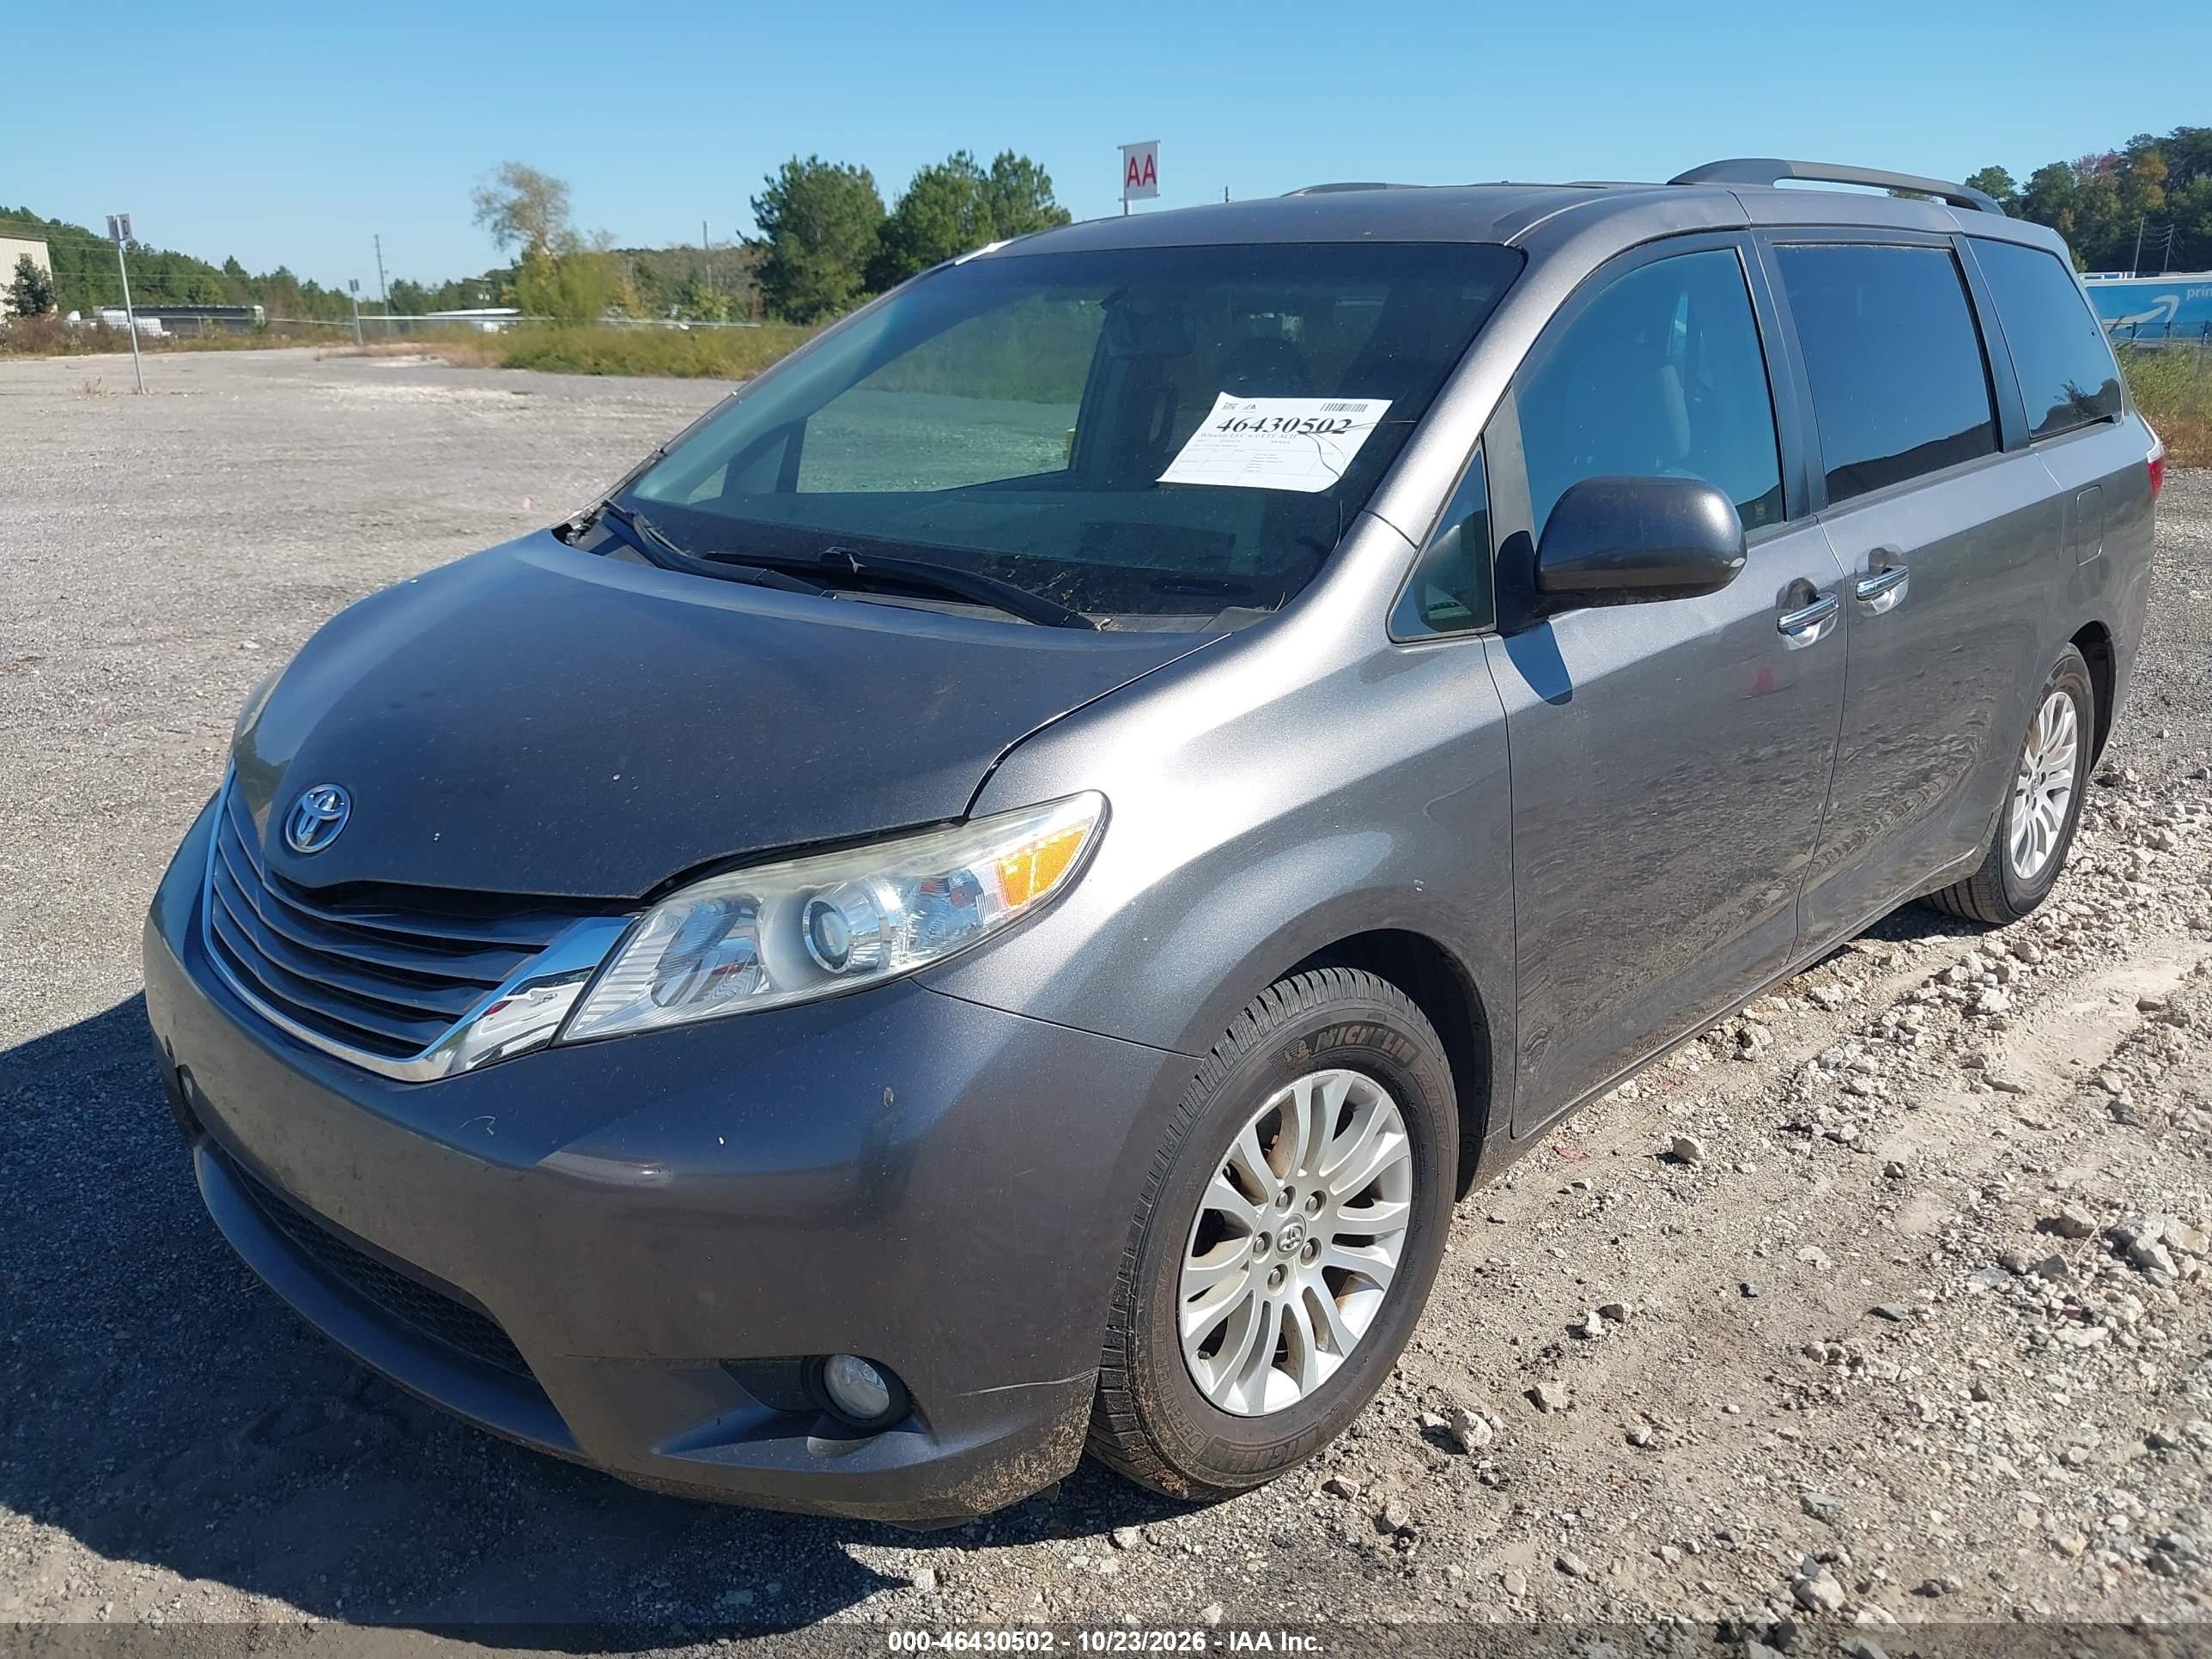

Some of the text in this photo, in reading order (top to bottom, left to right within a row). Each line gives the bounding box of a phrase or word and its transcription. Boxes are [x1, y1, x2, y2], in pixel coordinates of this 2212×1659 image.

[1127, 155, 1158, 187] AA
[1216, 416, 1352, 434] 46430502
[1315, 1024, 1416, 1064] MICHELIN
[1154, 1355, 1203, 1448] DEFENDER
